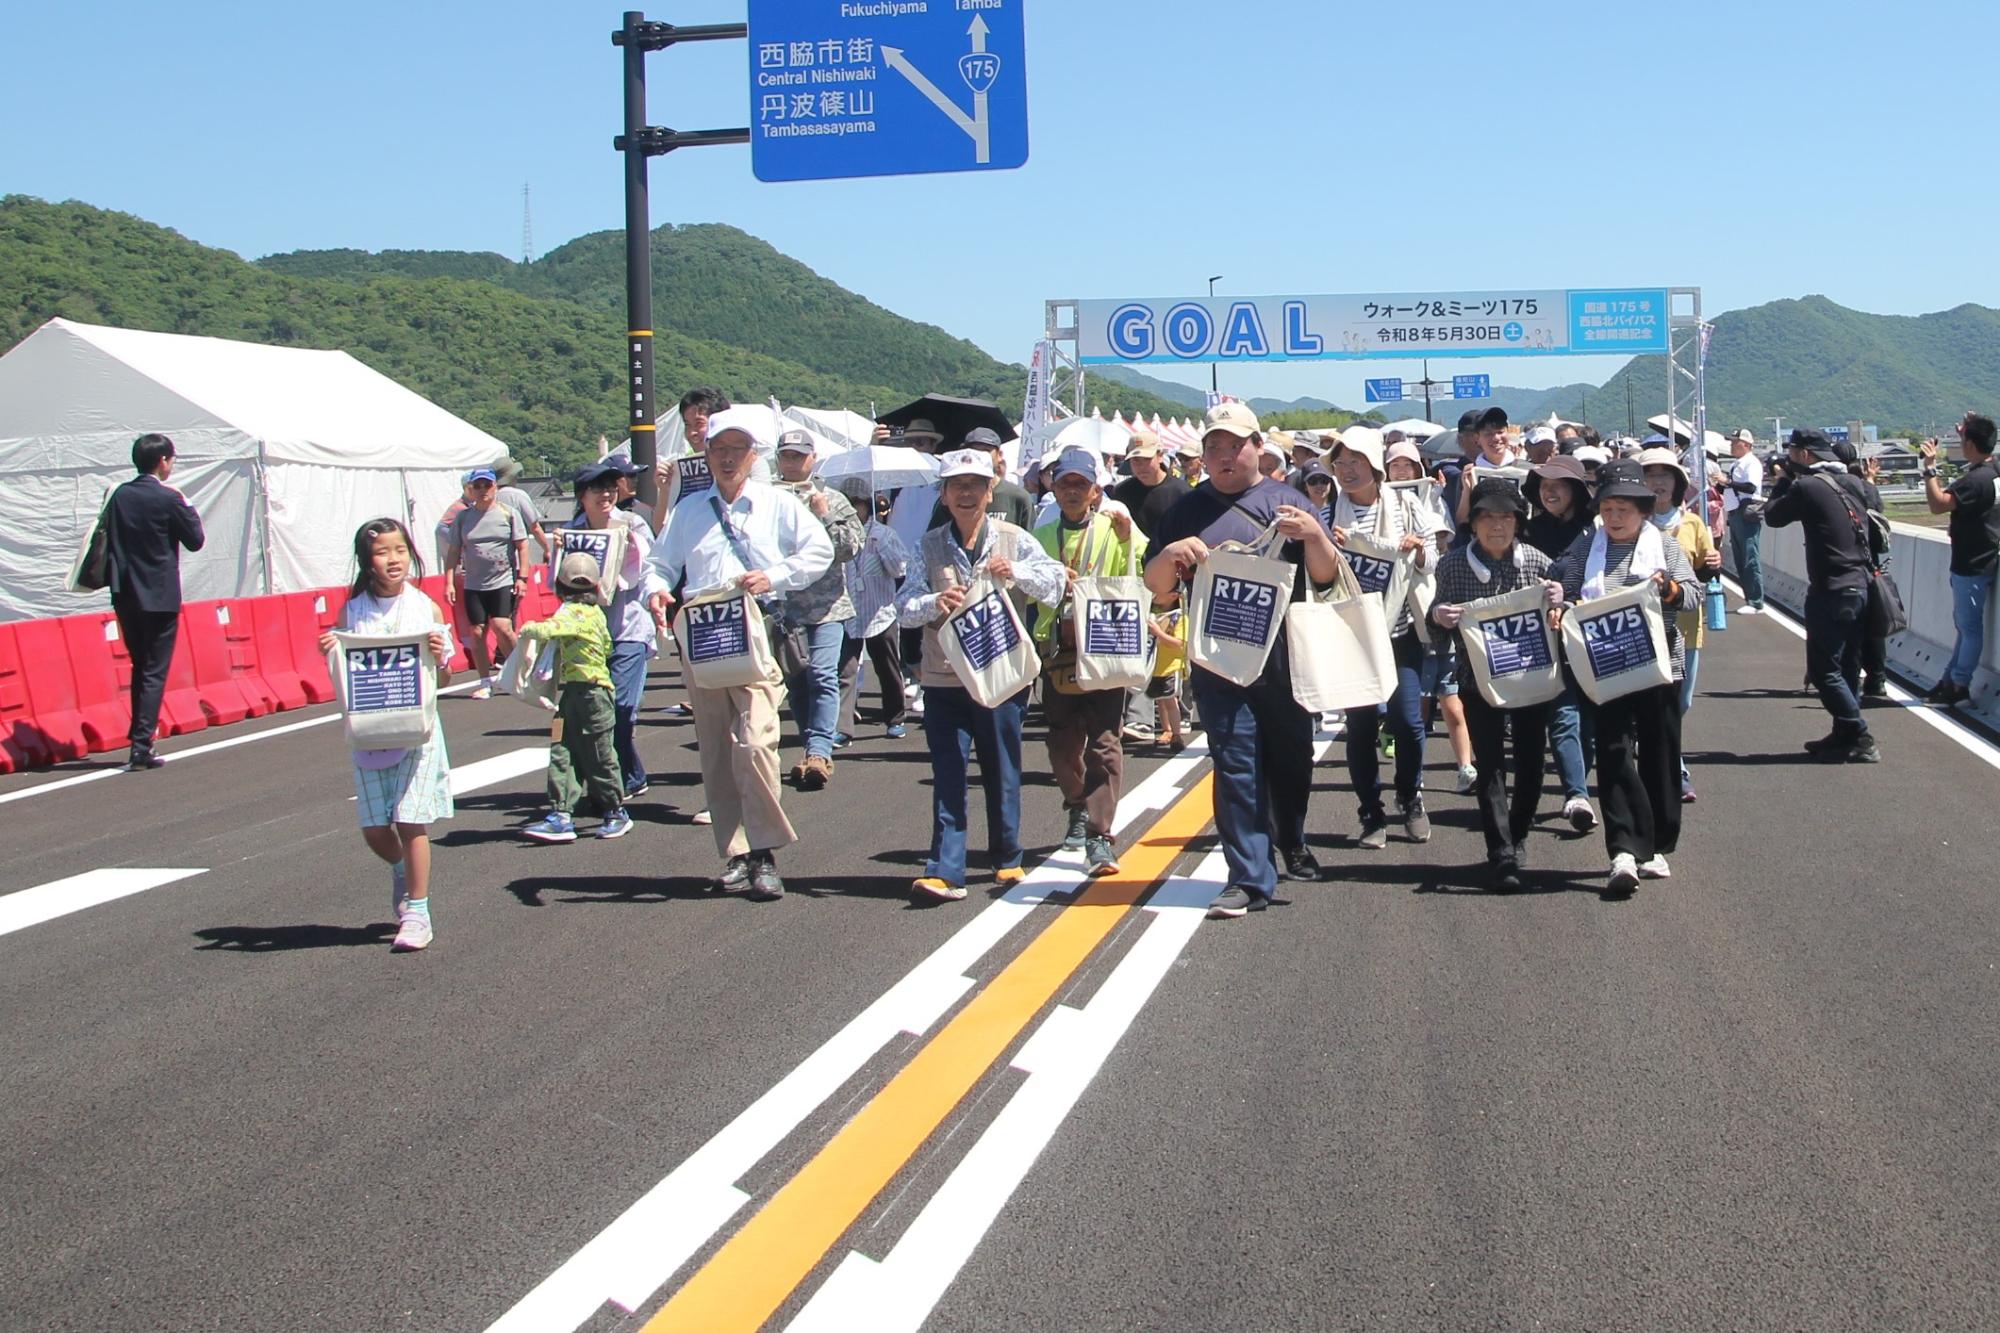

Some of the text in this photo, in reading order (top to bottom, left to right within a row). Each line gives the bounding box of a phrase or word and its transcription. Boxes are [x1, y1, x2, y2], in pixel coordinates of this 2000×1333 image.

[841, 1, 927, 17] Fukuchiyama
[955, 0, 1002, 10] Tamba
[759, 37, 874, 69] 西脇市街
[758, 66, 876, 87] Central Nishiwaki
[965, 60, 994, 79] 175
[760, 89, 874, 120] 丹波篠山
[761, 119, 876, 138] Tambasasayama
[1107, 300, 1323, 360] GOAL
[680, 458, 709, 477] R175
[565, 533, 607, 550] R175
[1214, 577, 1273, 607] R175
[688, 599, 743, 625] R175
[954, 593, 1003, 638] R175
[1089, 602, 1138, 620] R175
[1483, 612, 1540, 640] R175
[1583, 607, 1641, 641] R175
[350, 647, 416, 672] R175
